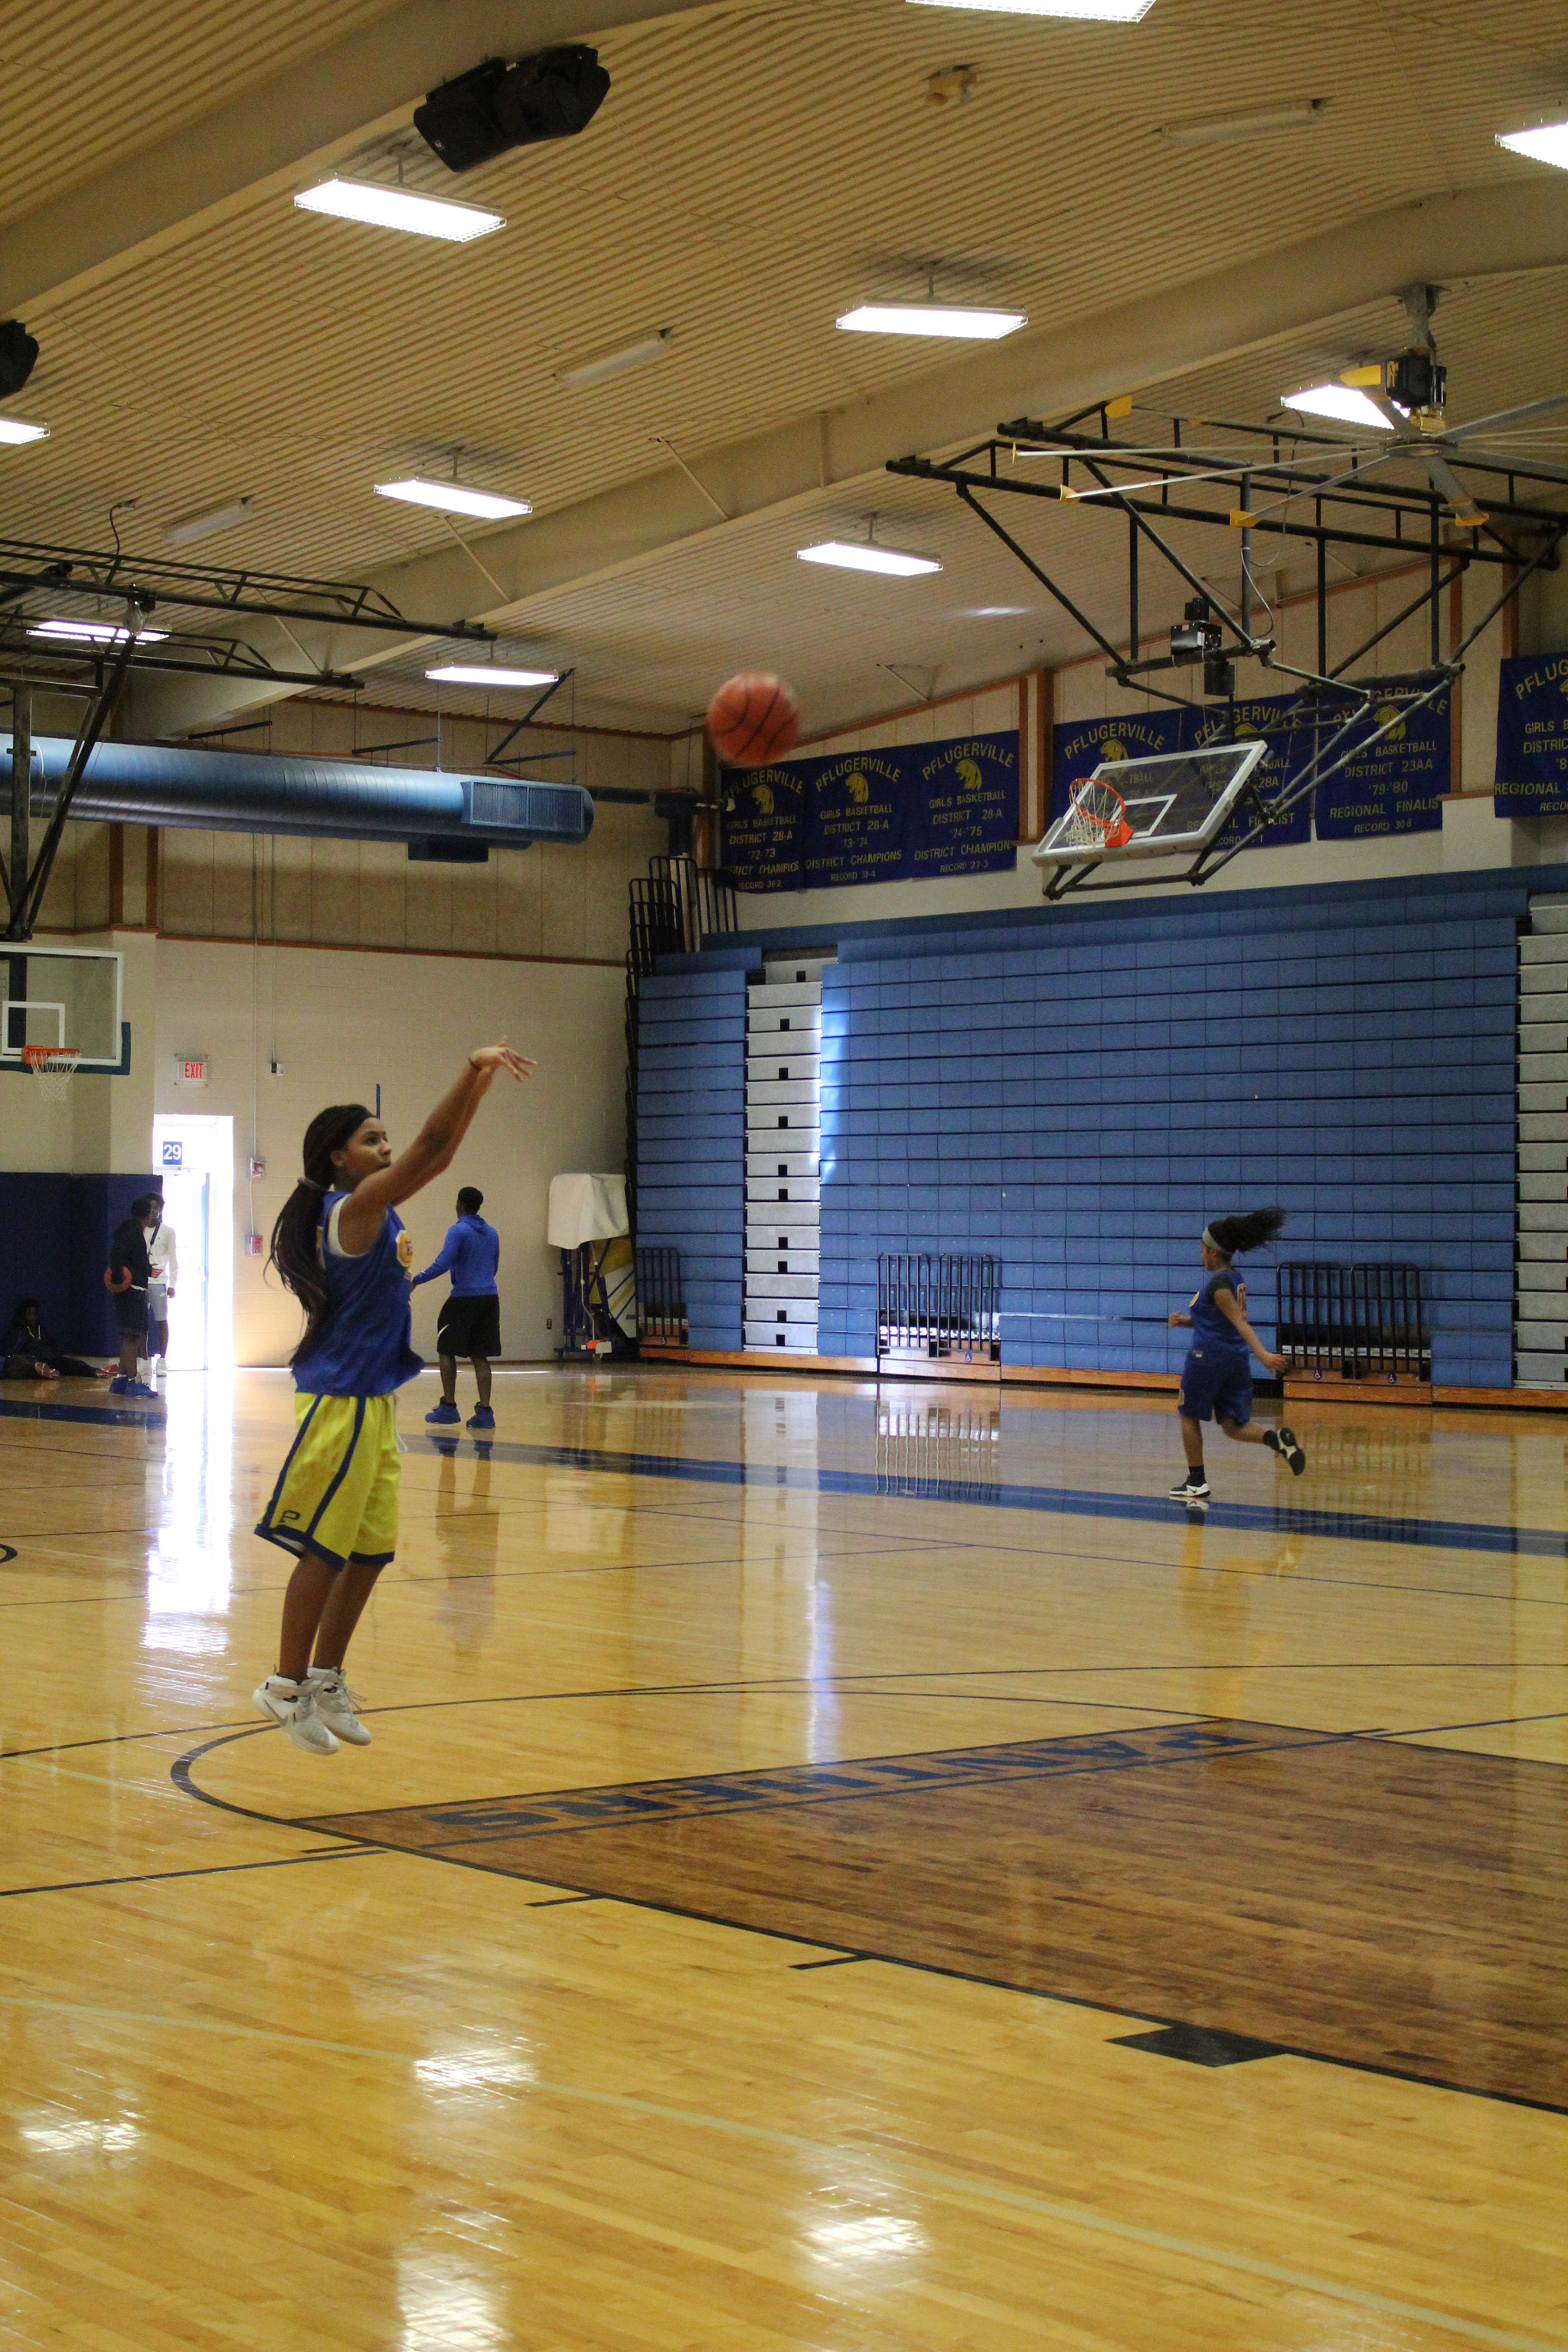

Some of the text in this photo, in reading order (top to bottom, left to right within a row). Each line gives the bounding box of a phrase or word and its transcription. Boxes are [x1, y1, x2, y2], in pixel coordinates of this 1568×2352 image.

[1524, 720, 1555, 735] GIRLS
[1064, 722, 1165, 760] PFLUGERVILLE
[1375, 740, 1437, 757] BASKETBALL
[922, 742, 1014, 781] PFLUGERVILLE
[1344, 758, 1433, 779] DISTRICT 23AA
[815, 756, 902, 793] PFLUGERVILLE
[1494, 782, 1560, 796] REGIONAL
[929, 789, 1006, 809] GIRLS BASKETBALL
[820, 803, 893, 820] GIRLS BASKETBALL
[933, 809, 972, 825] DISTRICT
[1330, 798, 1439, 819] REGIONAL FINALIS
[728, 815, 797, 831] GIRLS BASKETBALL
[824, 822, 862, 835] DISTRICT
[1354, 822, 1390, 834] RECORD
[729, 830, 793, 845] DISTRICT 28-A
[914, 839, 1012, 861] DISTRICT CHAMPION
[805, 850, 902, 870] DISTRICT CHAMPIONS
[940, 861, 967, 873] RECORD
[831, 871, 858, 883] RECORD
[185, 1063, 203, 1078] EXIT
[163, 1144, 181, 1161] 29
